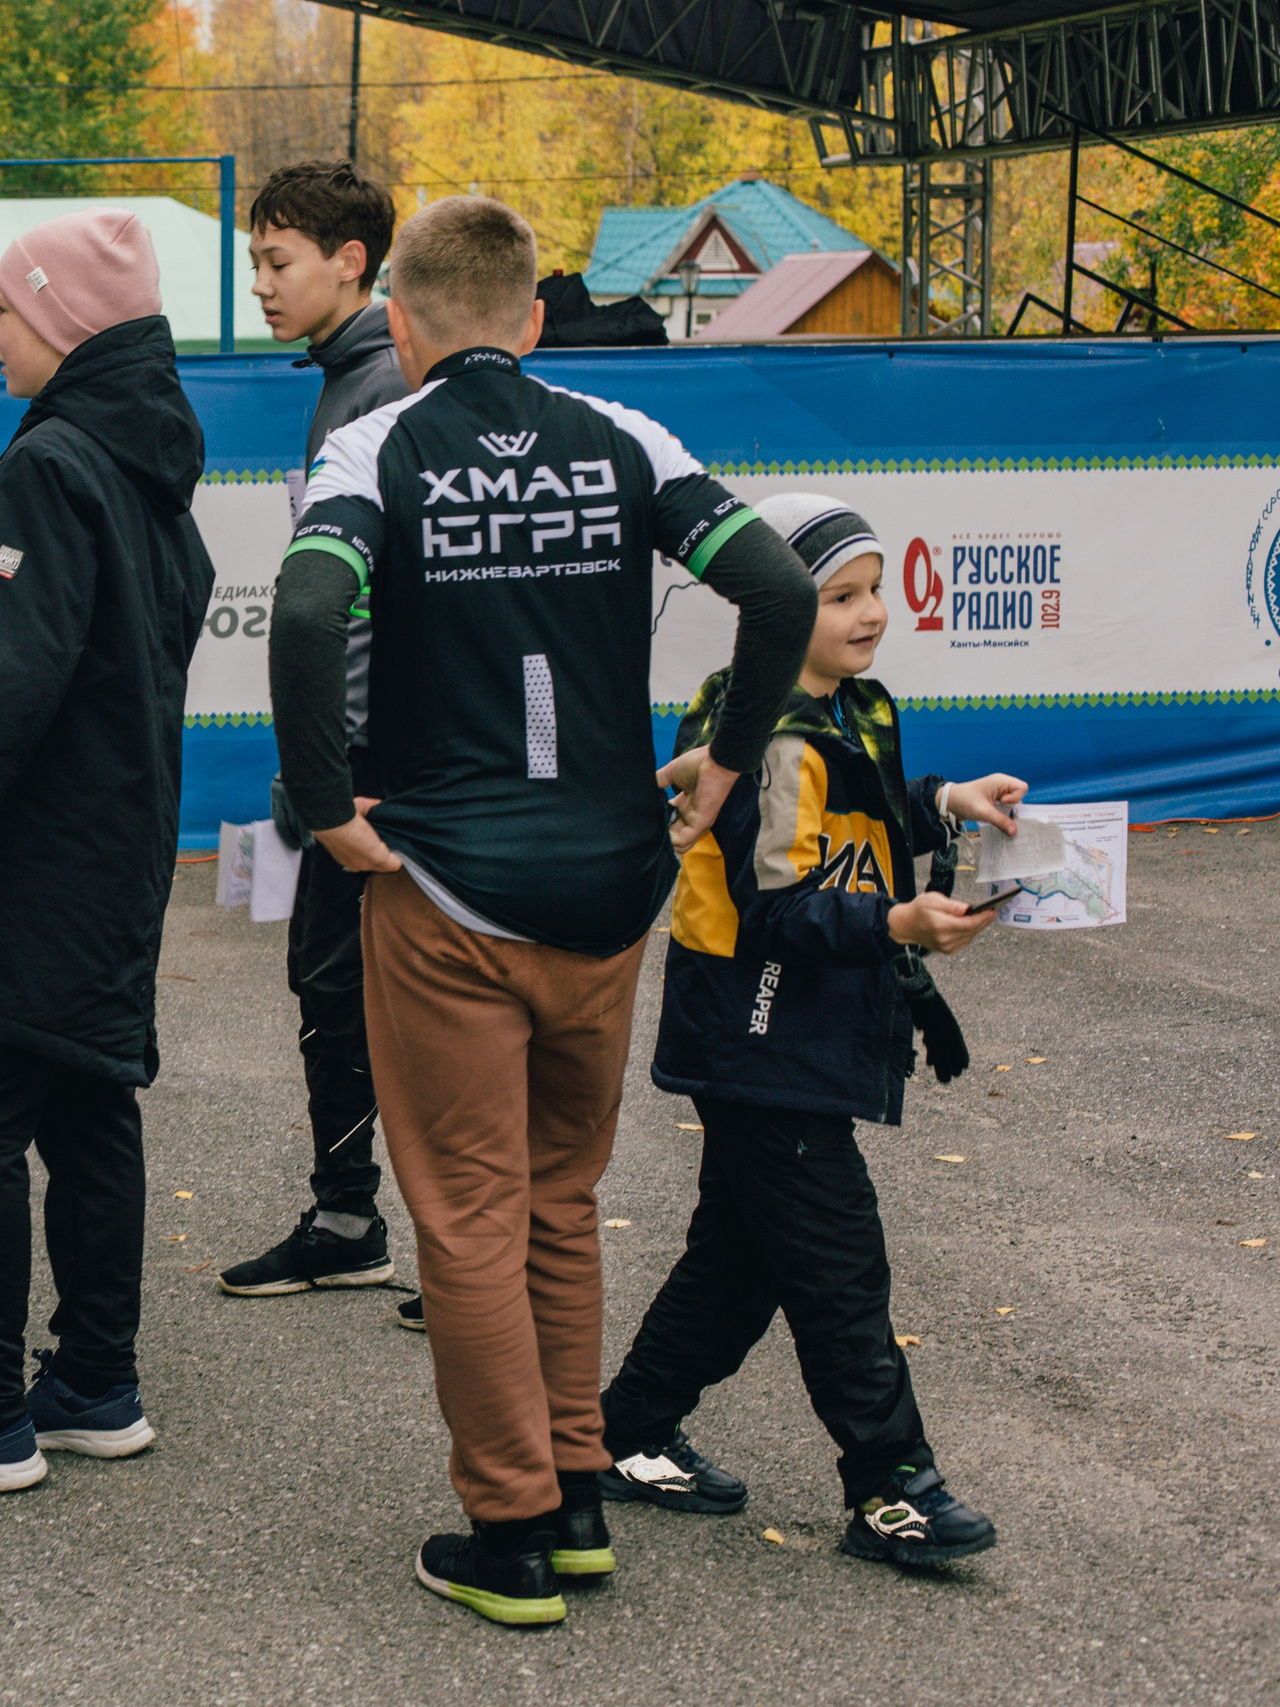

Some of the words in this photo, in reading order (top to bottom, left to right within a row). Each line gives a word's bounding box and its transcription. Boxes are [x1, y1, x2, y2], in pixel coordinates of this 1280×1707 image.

[422, 505, 621, 558] ЮГРА
[1018, 532, 1061, 540] ХОРОШО
[425, 558, 621, 583] НИЖНЕВАРТОВСК
[952, 544, 1061, 585] РУССКОЕ
[952, 591, 1032, 631] РАДИО
[1041, 589, 1061, 630] 102.9
[950, 640, 1029, 649] Ханты-Мансийск
[749, 961, 782, 1035] REAPER
